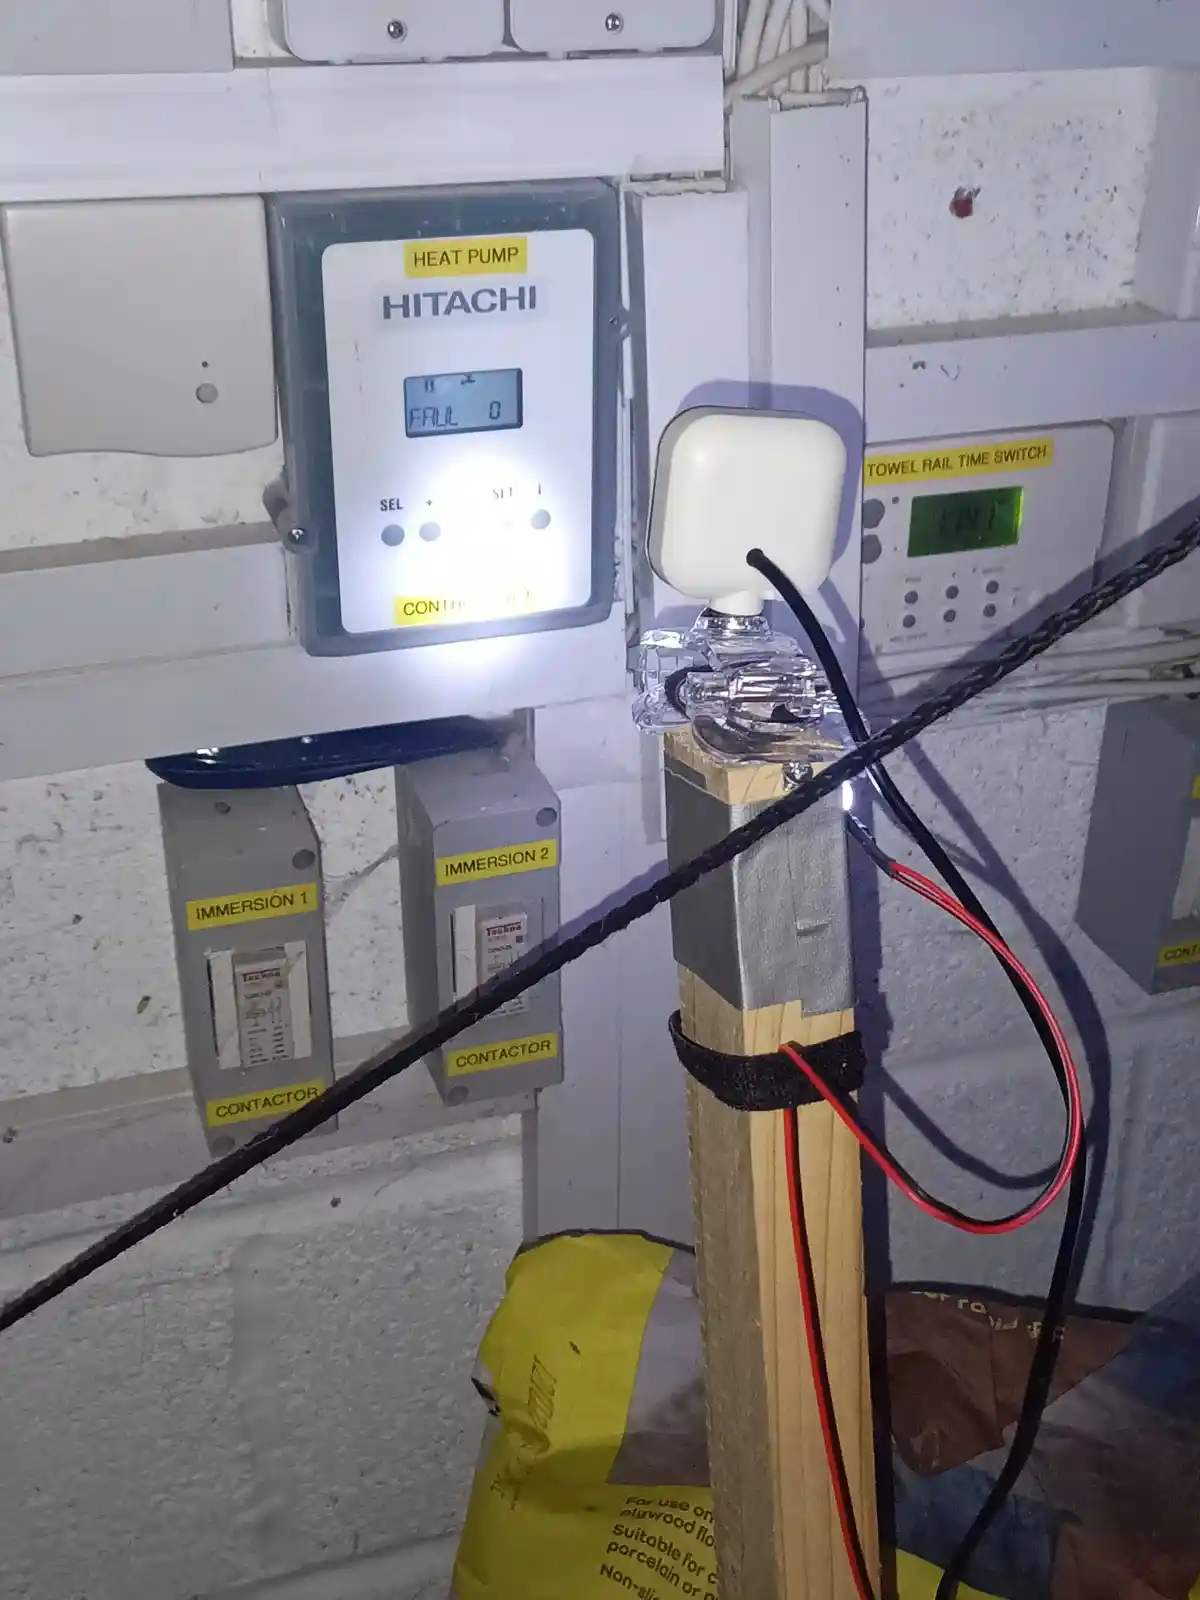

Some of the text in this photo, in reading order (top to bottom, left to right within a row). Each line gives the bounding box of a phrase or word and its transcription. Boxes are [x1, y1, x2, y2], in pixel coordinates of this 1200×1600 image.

[413, 246, 520, 268] HEAT PUMP
[382, 284, 537, 320] HITACHI
[867, 444, 1047, 477] TOWEL RAIL TIME SWITCH
[379, 498, 404, 512] SEL
[445, 848, 549, 877] IMMERSION 2
[196, 892, 309, 921] IMMERSION 1
[1164, 943, 1200, 961] CONT
[456, 1039, 551, 1067] CONTACTOR
[215, 1086, 318, 1118] CONTACTOR
[659, 1498, 690, 1511] use
[694, 1506, 714, 1523] on
[619, 1508, 717, 1549] plywood flo
[606, 1541, 680, 1587] porcelain
[682, 1581, 702, 1597] or
[682, 1552, 705, 1576] for
[600, 1563, 659, 1600] Non-sli
